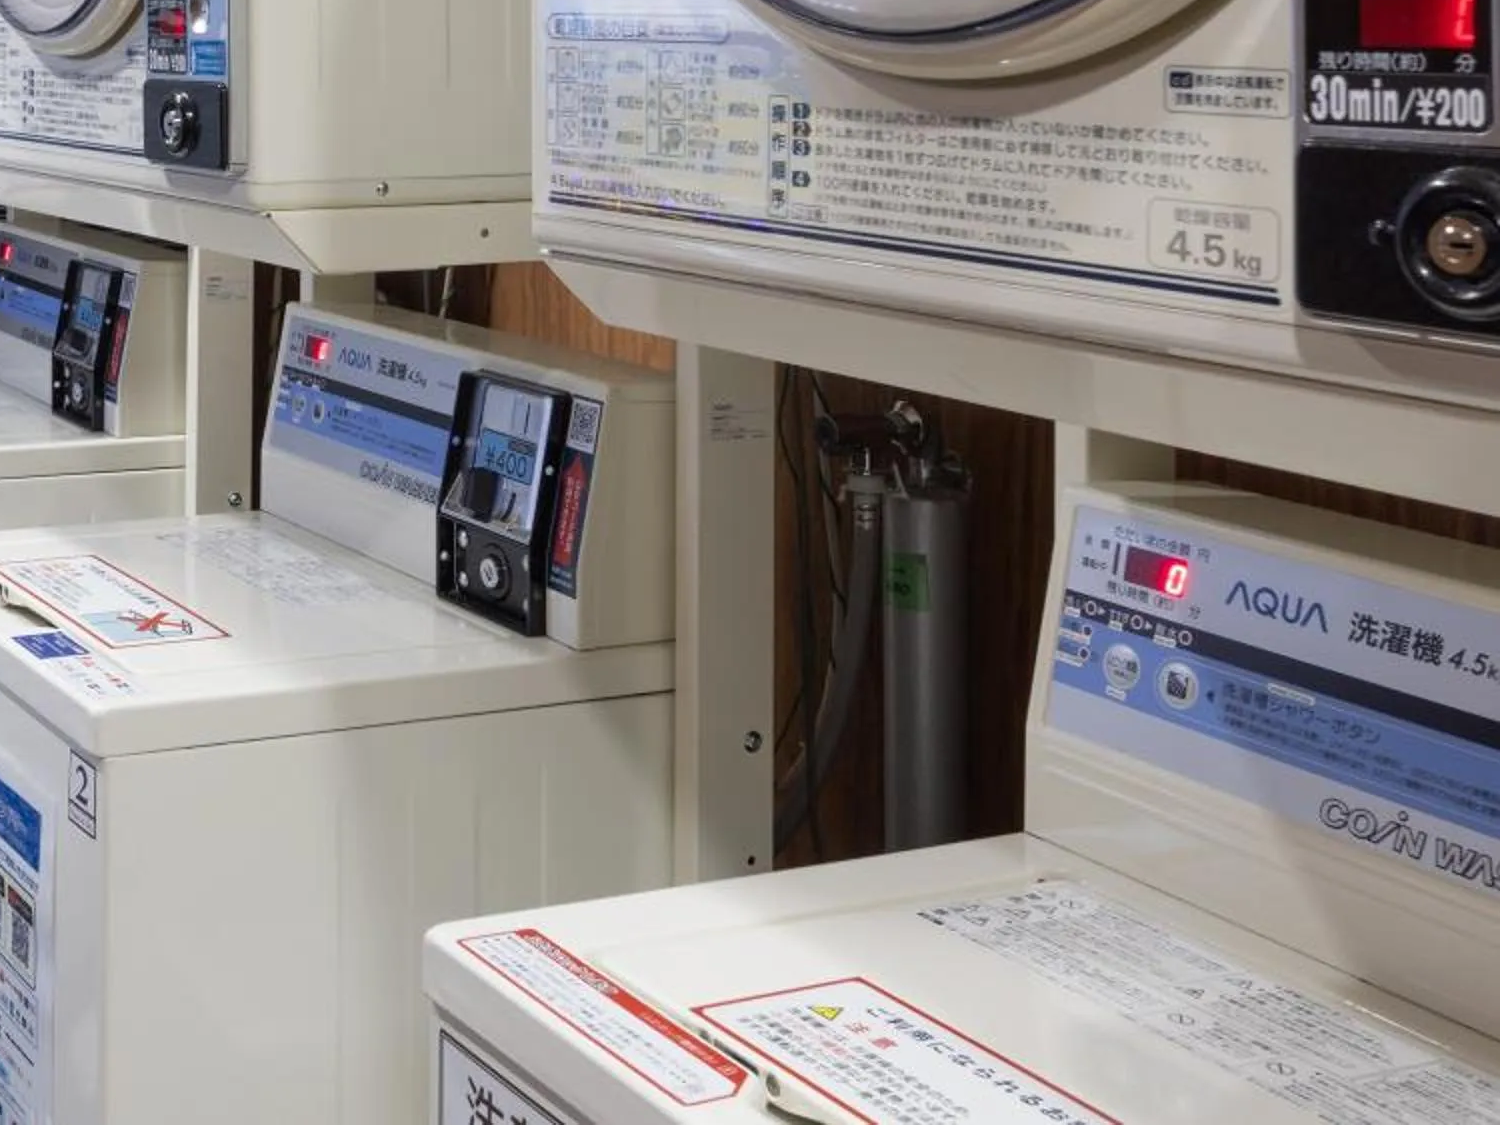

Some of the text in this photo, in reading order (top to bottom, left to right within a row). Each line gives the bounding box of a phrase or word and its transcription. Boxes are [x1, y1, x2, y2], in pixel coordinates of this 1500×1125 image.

[1453, 54, 1477, 74] 分
[1310, 74, 1487, 128] 30min/¥200
[1165, 230, 1263, 276] 4.5 kg
[338, 346, 373, 370] AQUA
[485, 443, 528, 478] ¥400
[1163, 563, 1190, 596] 0
[1224, 579, 1329, 635] AQUA
[1347, 610, 1500, 684] 洗濯機 4.5k
[75, 764, 89, 807] 2
[1434, 836, 1500, 892] WA
